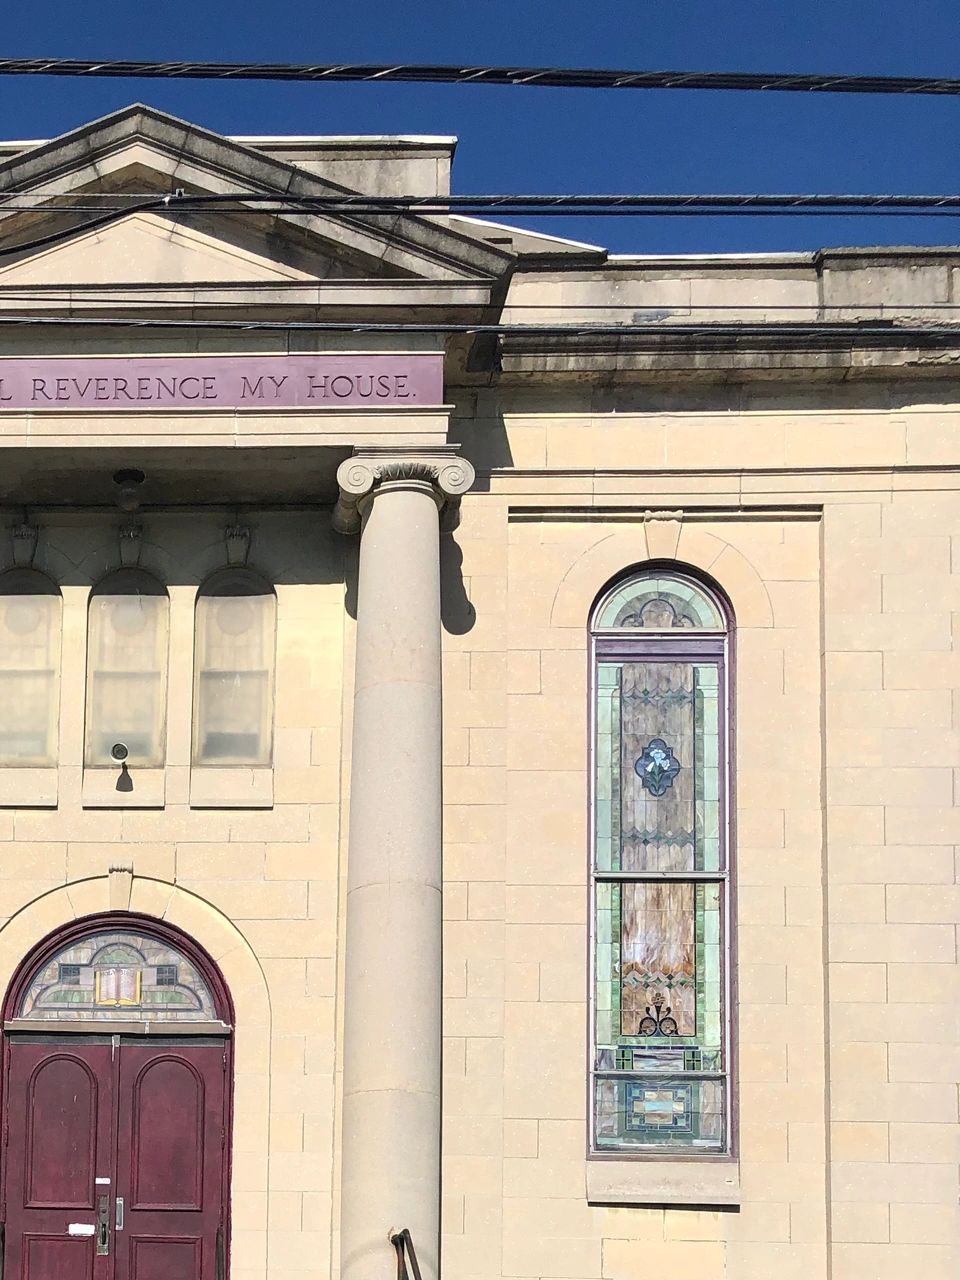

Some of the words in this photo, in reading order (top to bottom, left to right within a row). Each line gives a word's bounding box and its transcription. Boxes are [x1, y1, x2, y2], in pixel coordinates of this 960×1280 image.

[30, 376, 218, 401] REVERENCE
[240, 375, 289, 399] MY
[306, 374, 417, 399] HOUSE.
